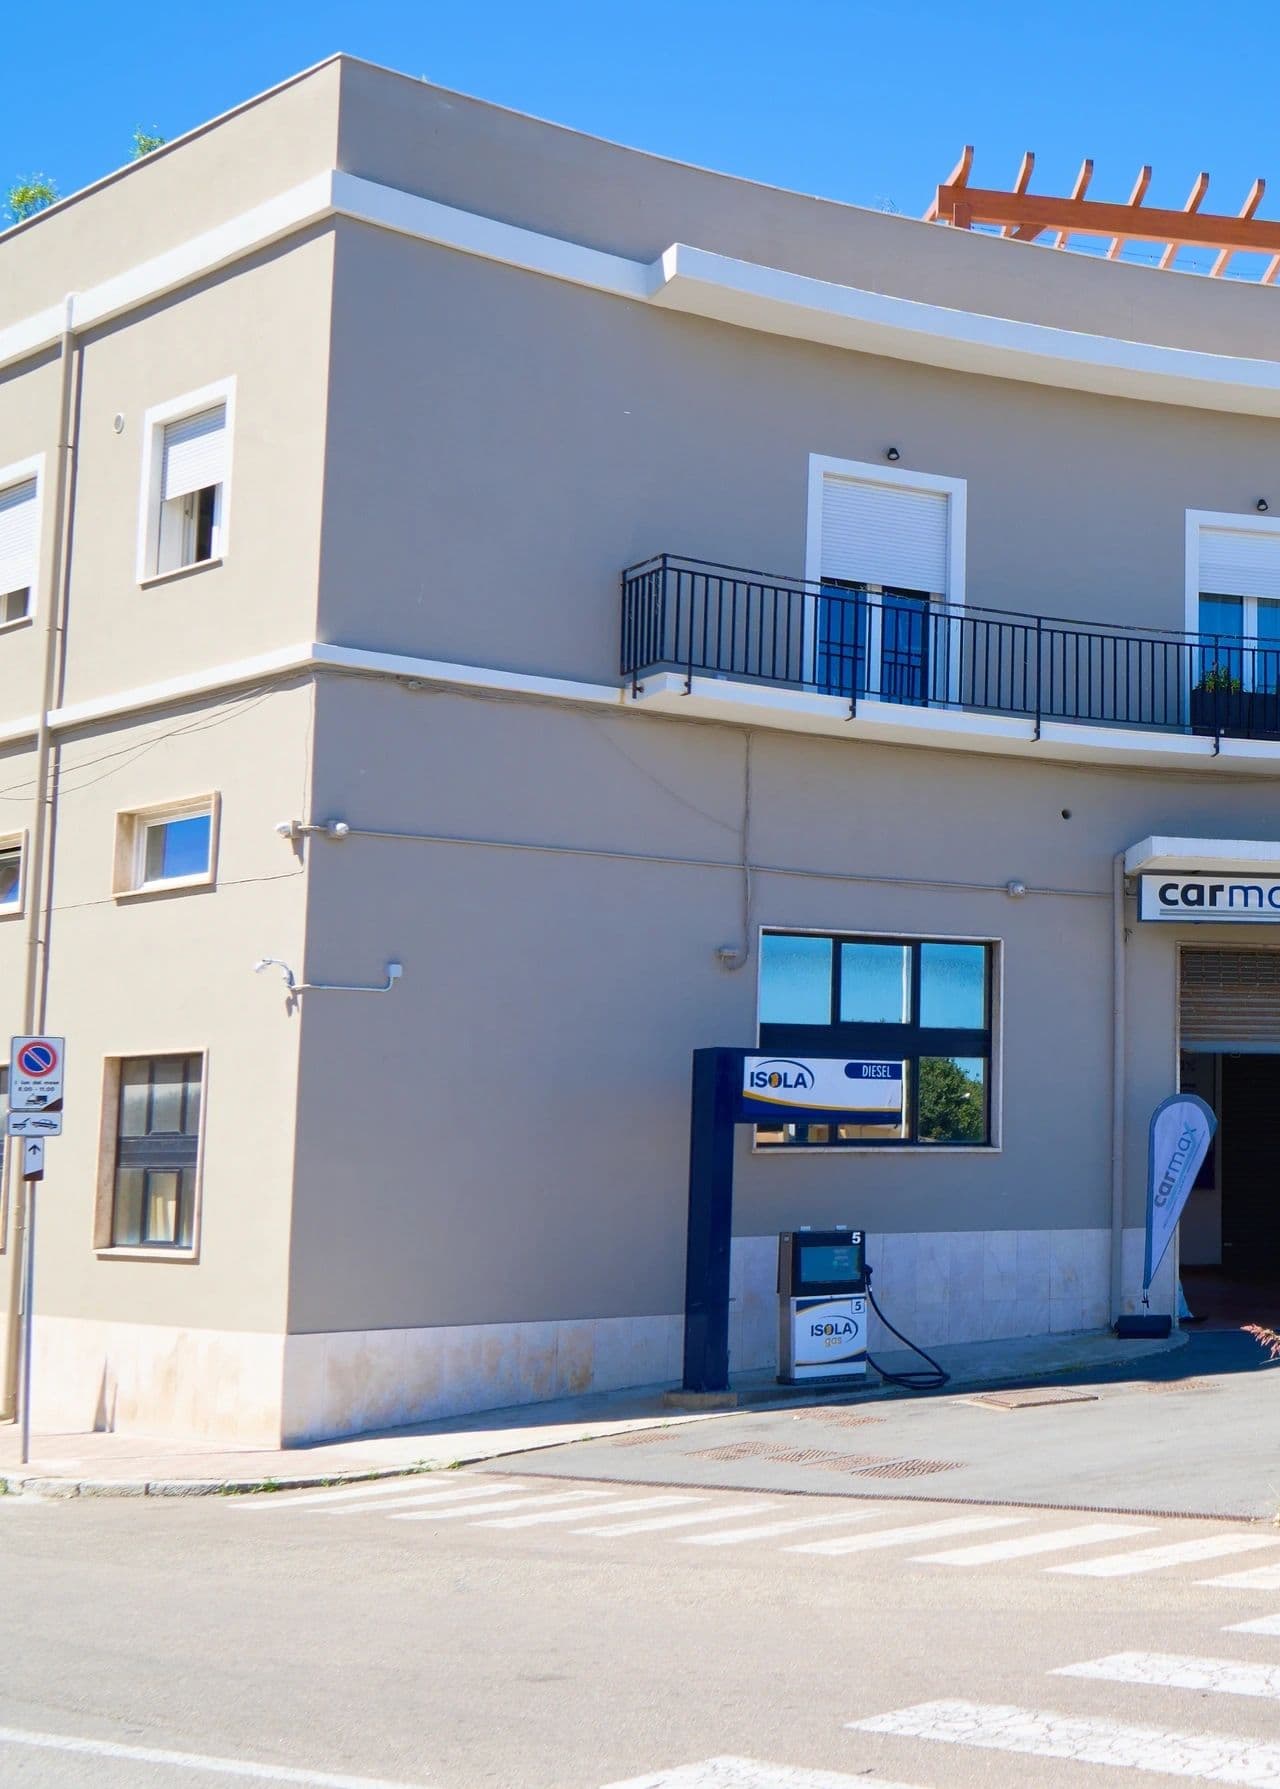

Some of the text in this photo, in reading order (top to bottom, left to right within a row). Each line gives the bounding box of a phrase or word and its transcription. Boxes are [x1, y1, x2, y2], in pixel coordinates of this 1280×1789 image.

[862, 1064, 892, 1078] DIESEL
[750, 1071, 808, 1089] ISOLA
[1154, 1120, 1197, 1208] carmax
[851, 1232, 861, 1244] 5
[855, 1301, 862, 1311] 5
[810, 1322, 853, 1337] ISOLA
[824, 1337, 842, 1348] gas
